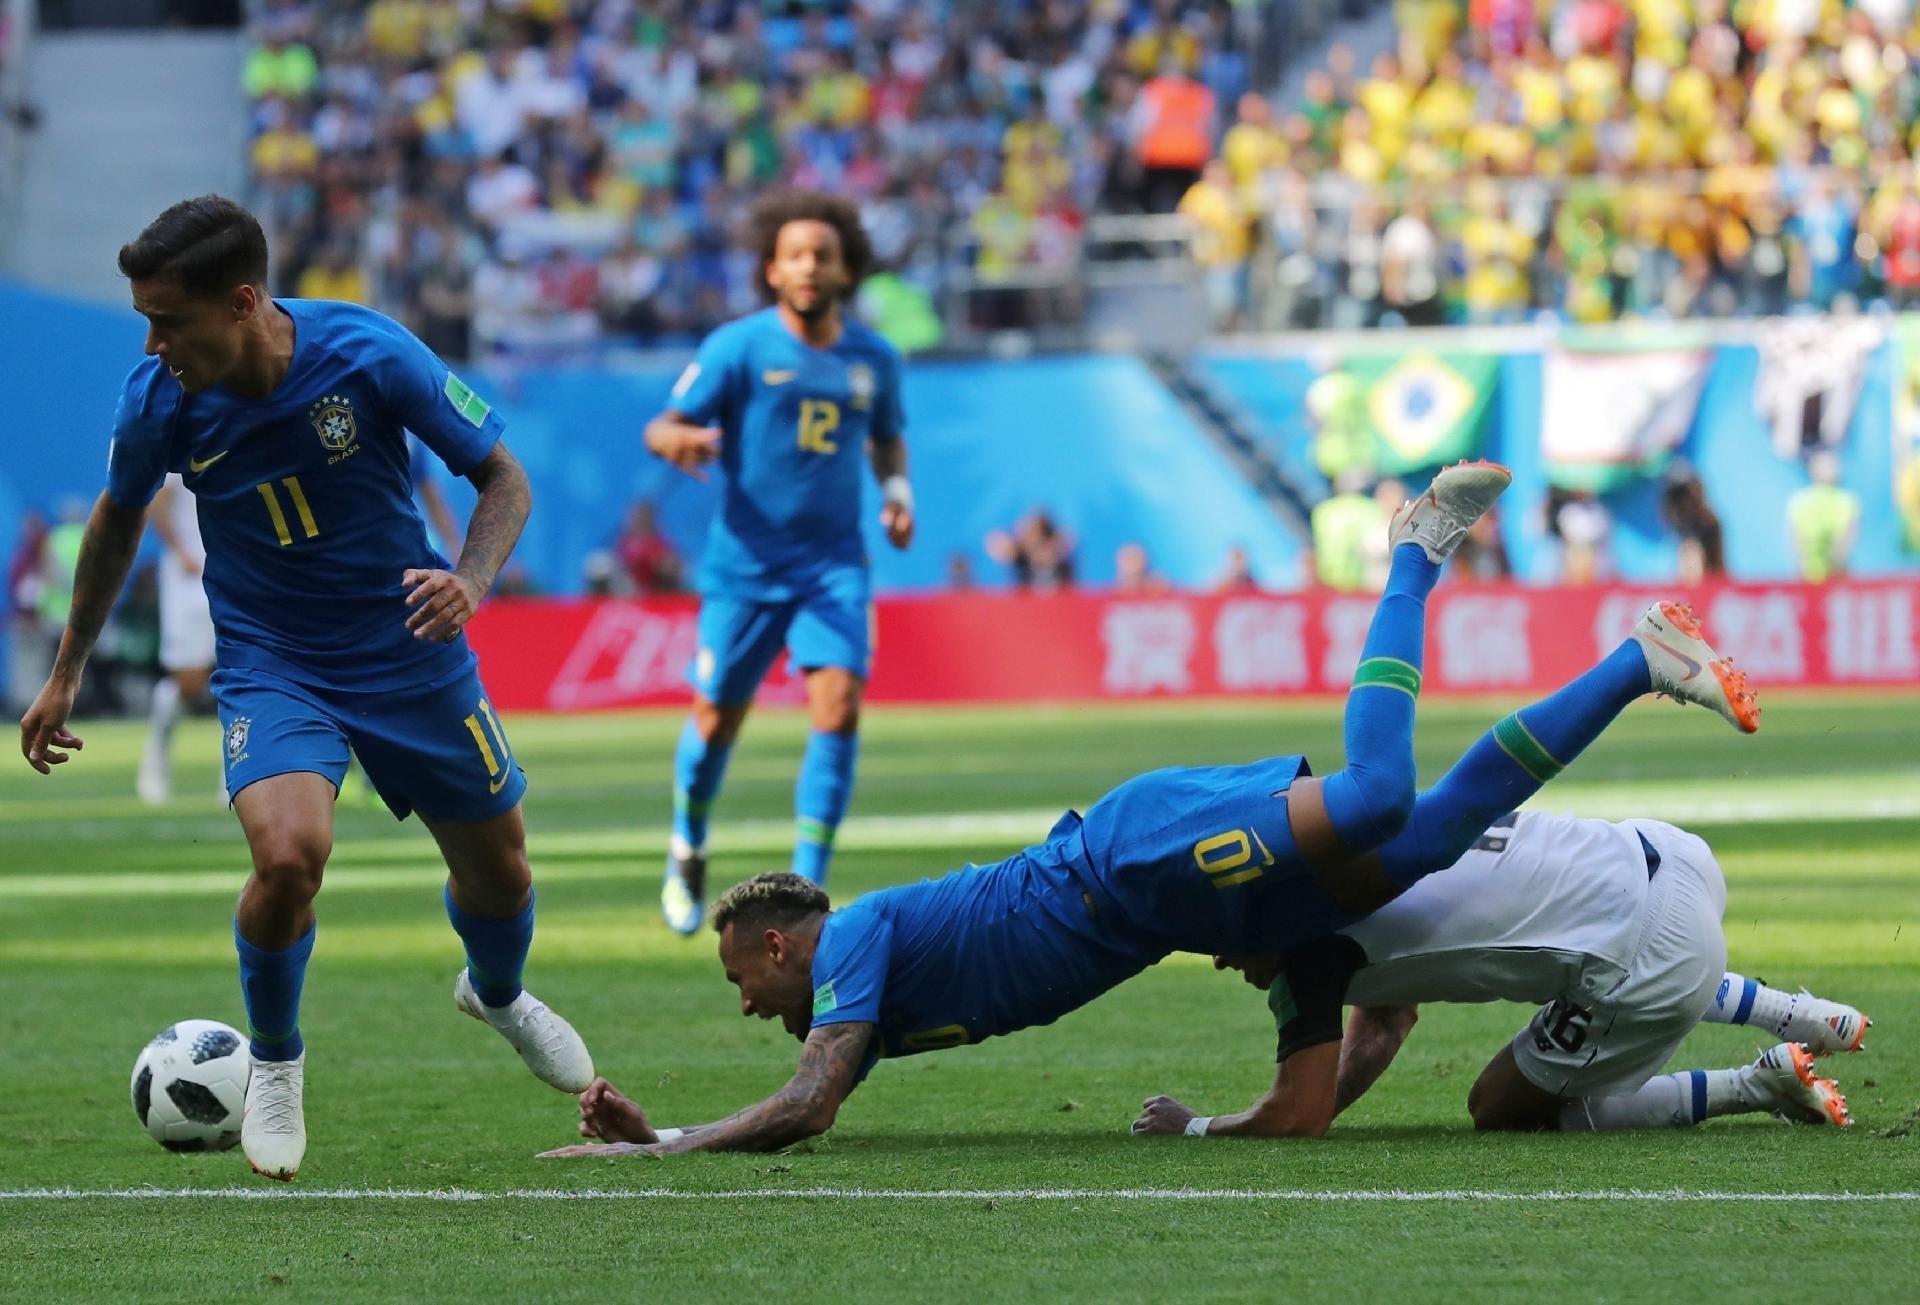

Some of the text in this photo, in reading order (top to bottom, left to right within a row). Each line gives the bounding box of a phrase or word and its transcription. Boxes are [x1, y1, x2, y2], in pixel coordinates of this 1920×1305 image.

[328, 444, 361, 466] BRASIL
[798, 400, 841, 455] 12
[257, 476, 320, 546] 11
[464, 698, 508, 777] 11
[1194, 829, 1263, 890] 10
